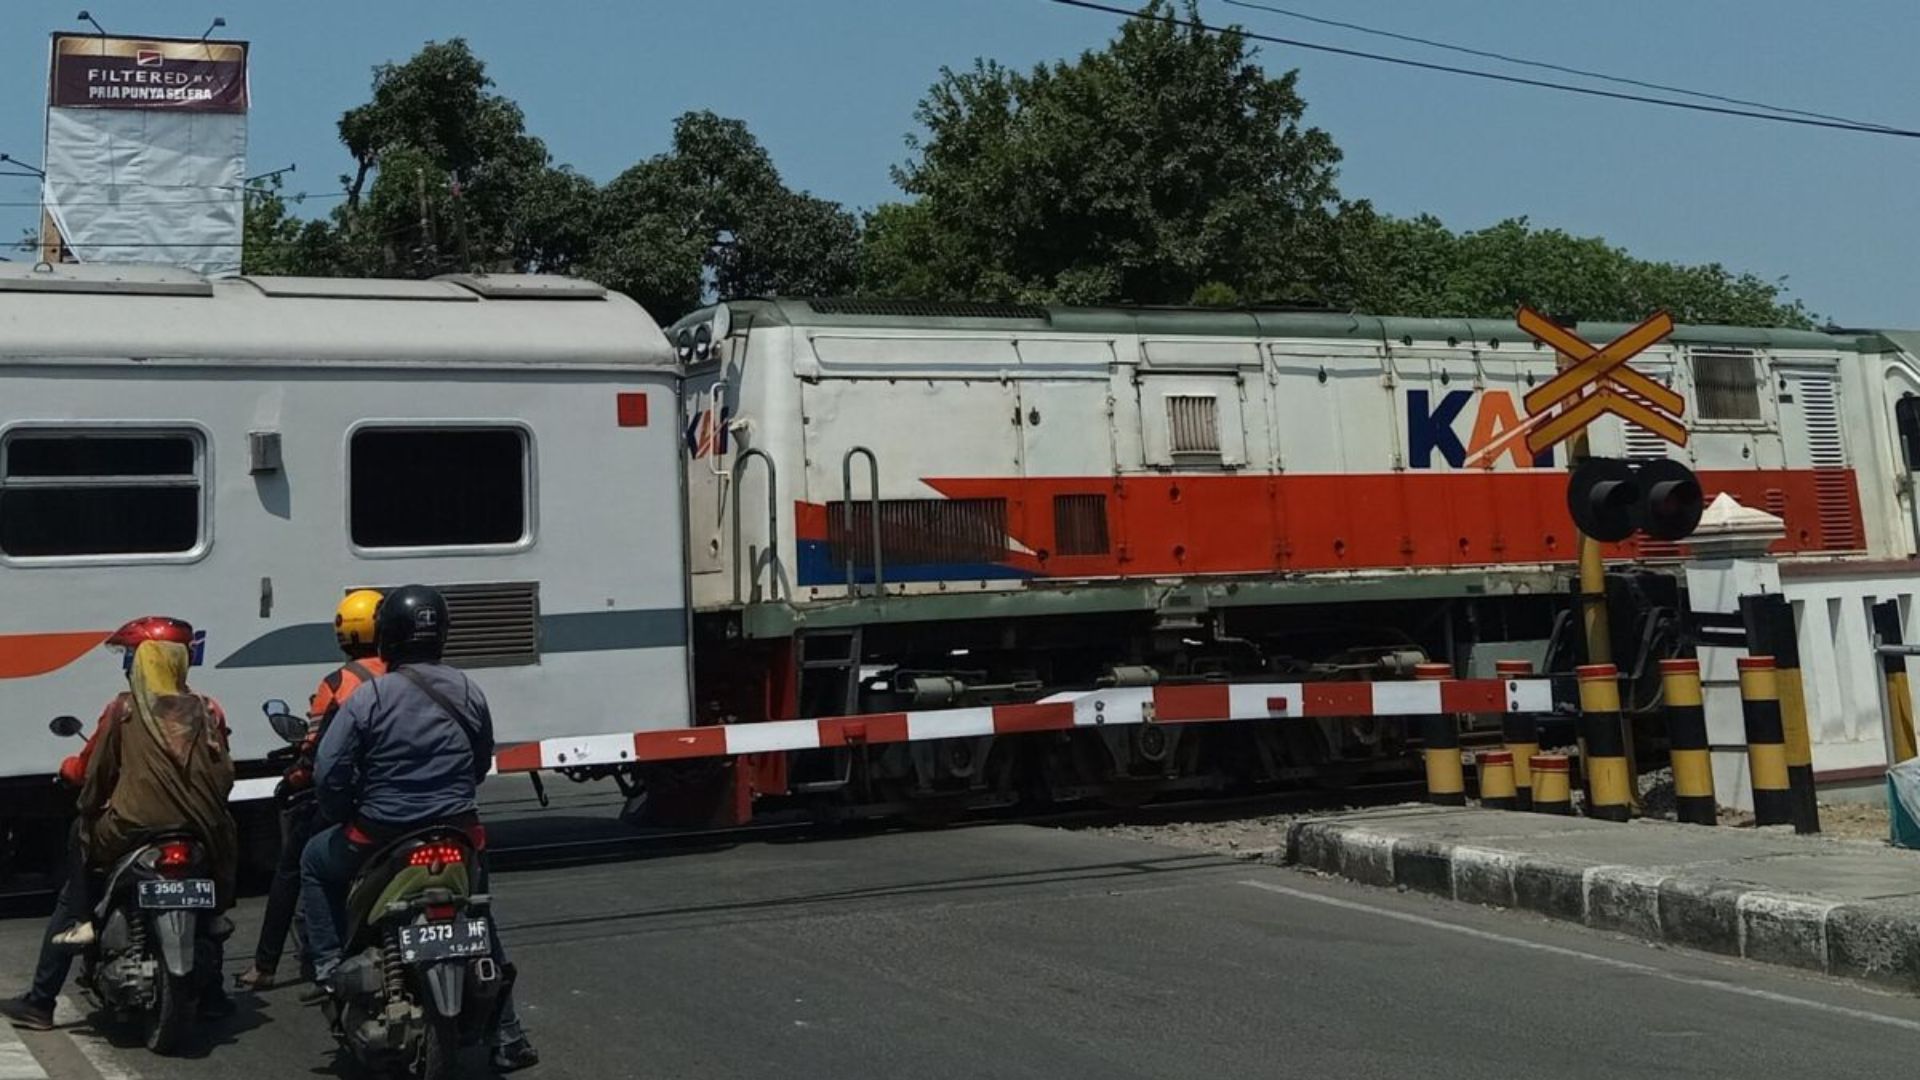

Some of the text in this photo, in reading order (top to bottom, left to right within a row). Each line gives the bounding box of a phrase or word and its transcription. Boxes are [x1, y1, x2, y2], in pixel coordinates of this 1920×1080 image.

[88, 69, 188, 84] FILTERED
[89, 86, 212, 100] PRIA PUNYA SELERA
[140, 883, 147, 895] E
[402, 929, 411, 945] E
[419, 924, 454, 943] 2573
